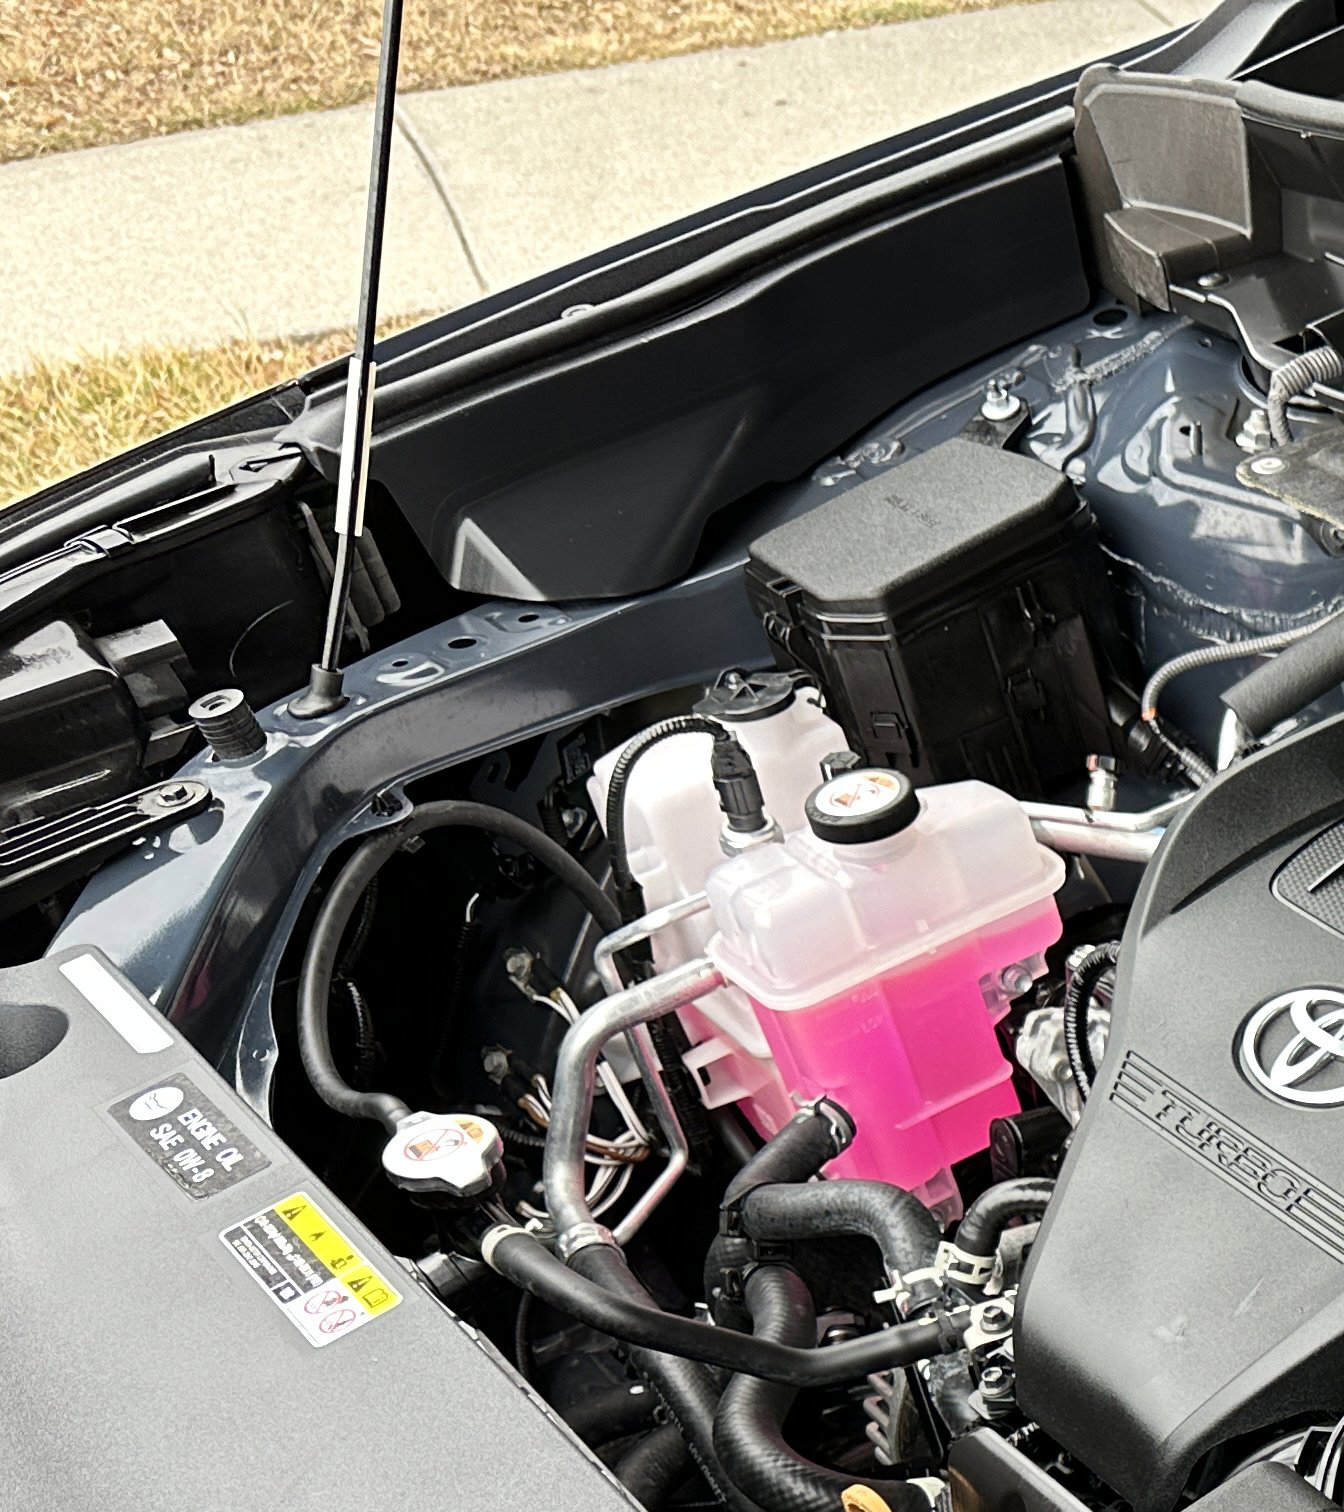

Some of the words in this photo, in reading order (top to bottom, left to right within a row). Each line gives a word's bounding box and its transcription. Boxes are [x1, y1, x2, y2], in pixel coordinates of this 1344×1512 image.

[150, 1123, 184, 1150] SAE
[173, 1148, 215, 1183] 0W-8
[178, 1108, 227, 1150] ENGINE
[216, 1147, 244, 1172] OIL
[1156, 1089, 1300, 1202] TURBO
